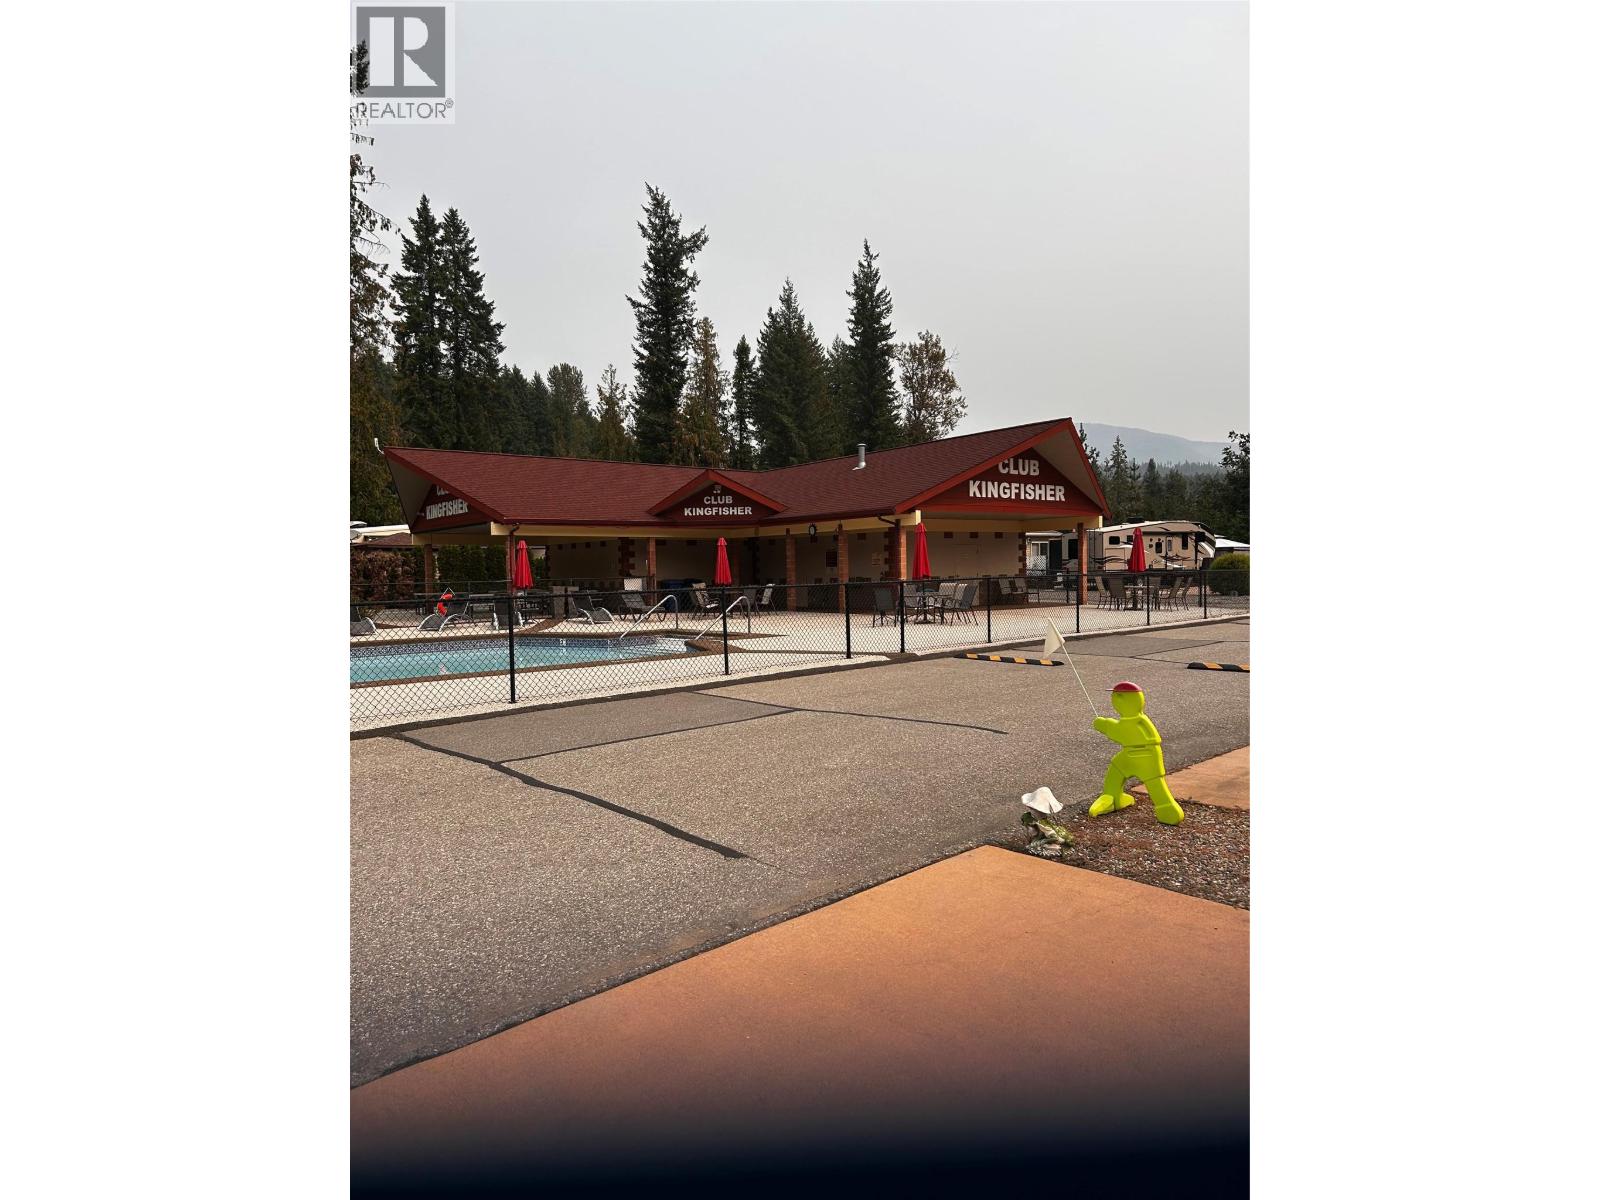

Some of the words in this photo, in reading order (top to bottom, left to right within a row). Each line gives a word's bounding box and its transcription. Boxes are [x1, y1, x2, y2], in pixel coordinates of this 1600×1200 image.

[998, 458, 1040, 476] CLUB
[969, 480, 1066, 502] KINGFISHER
[703, 496, 733, 505] CLUB
[684, 506, 753, 516] KINGFISHER
